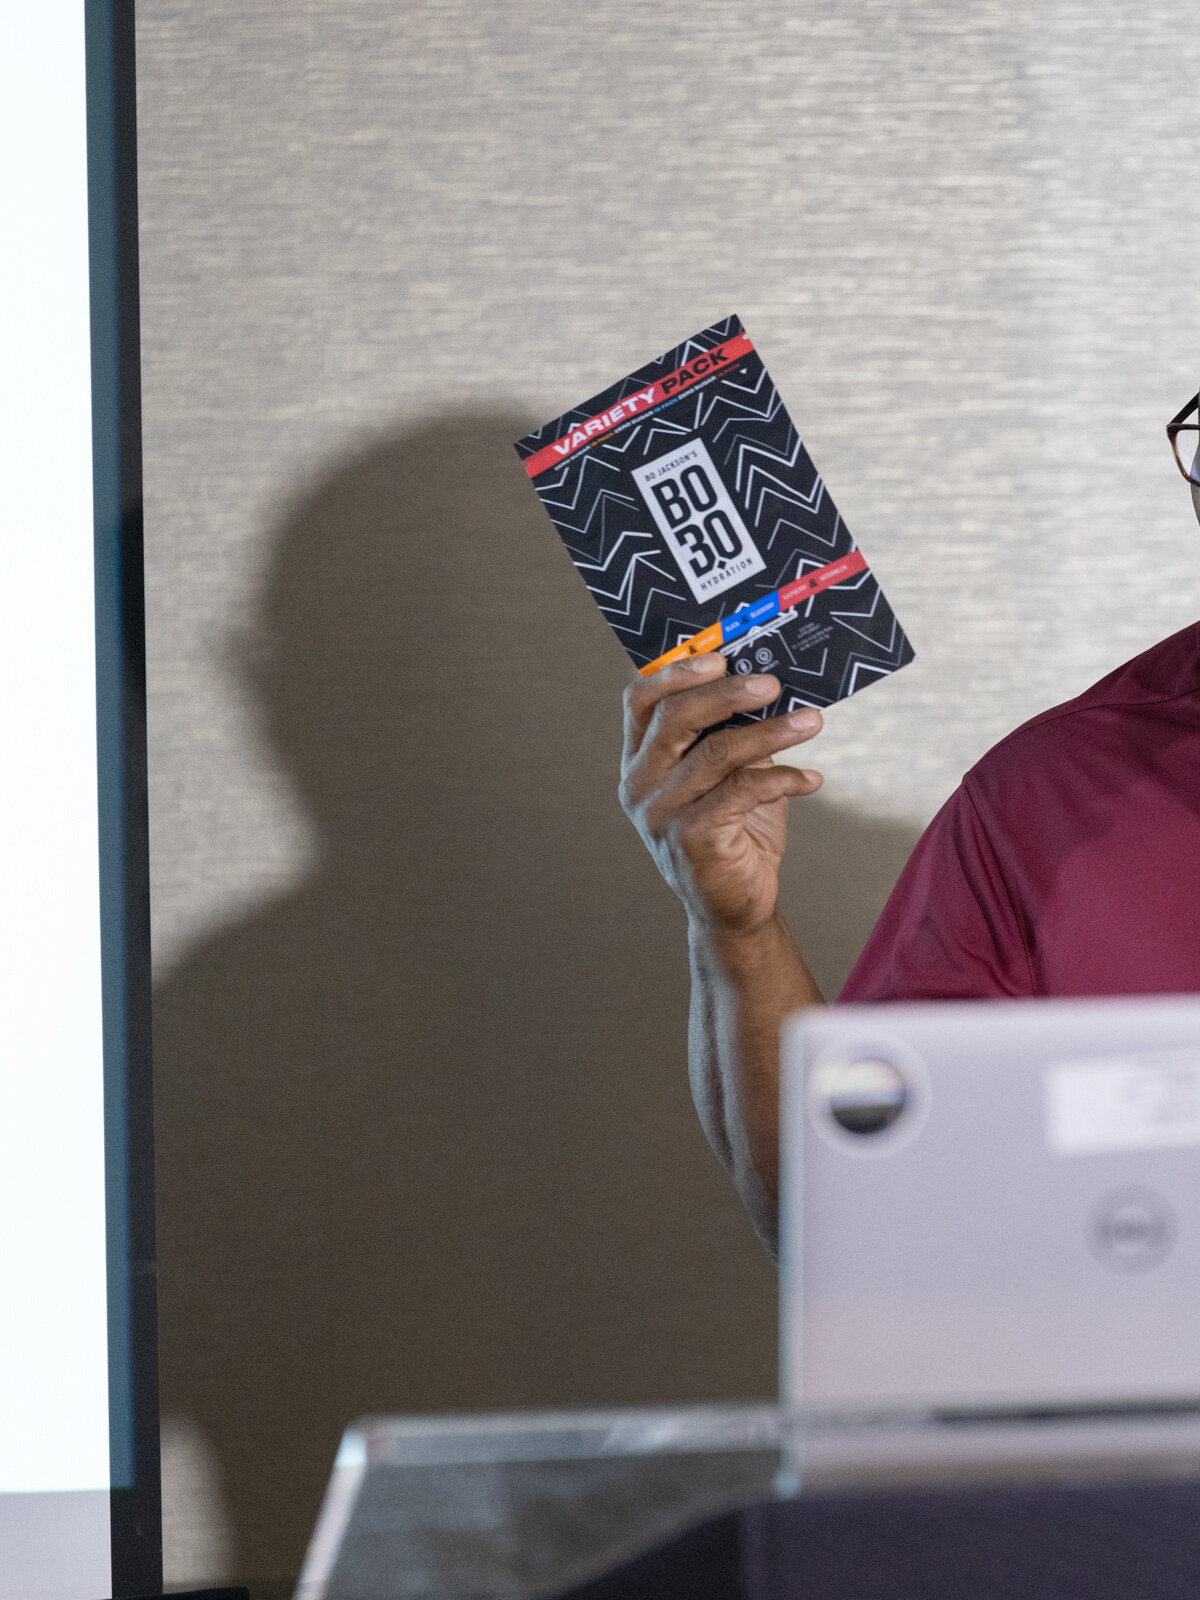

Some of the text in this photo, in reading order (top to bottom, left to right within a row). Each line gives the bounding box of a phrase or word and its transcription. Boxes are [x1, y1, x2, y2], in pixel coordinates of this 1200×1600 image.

[552, 348, 729, 455] VARIETY PACK
[645, 450, 698, 482] BO JACKSON'S
[651, 465, 718, 530] BO
[674, 510, 743, 578] 30
[700, 557, 754, 591] HYDRATION
